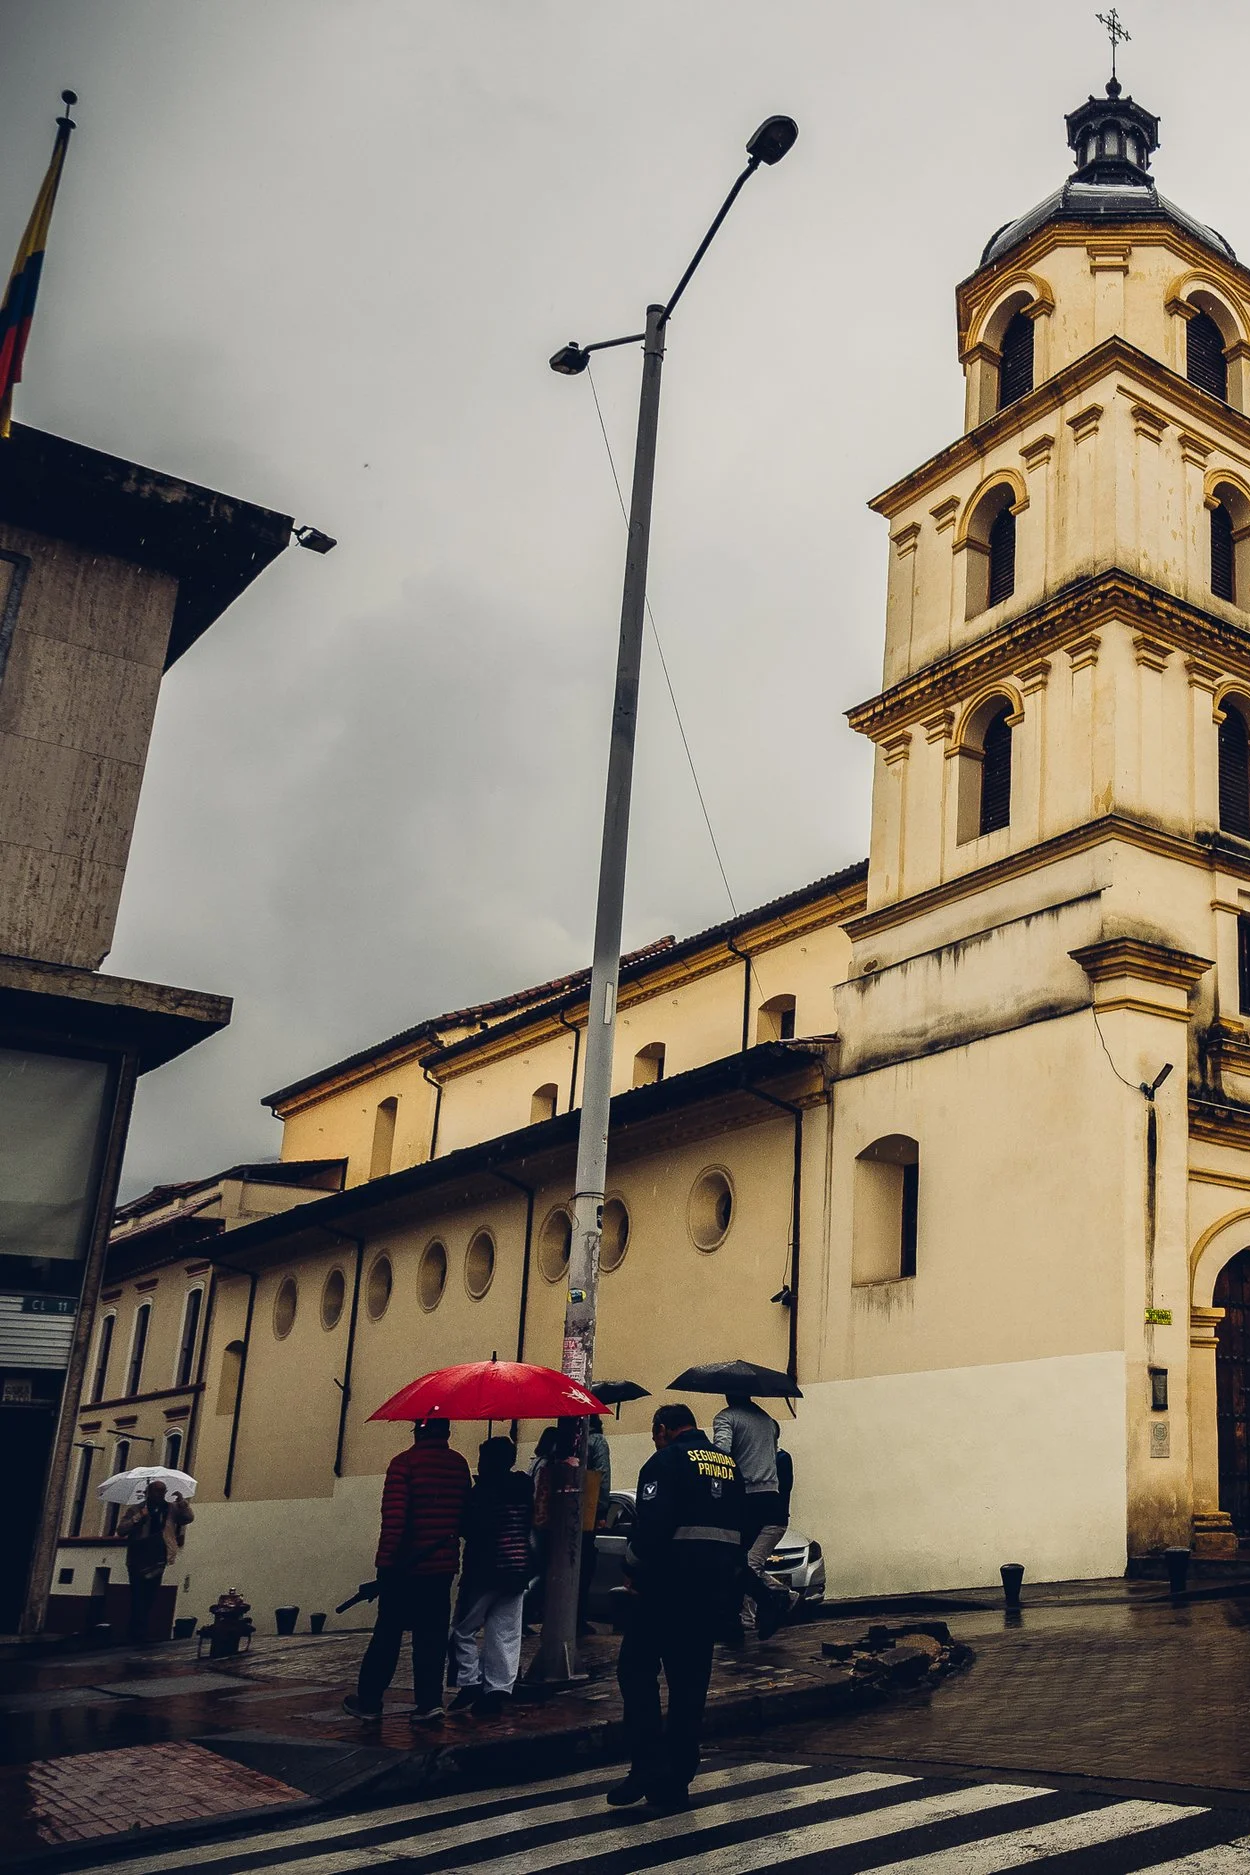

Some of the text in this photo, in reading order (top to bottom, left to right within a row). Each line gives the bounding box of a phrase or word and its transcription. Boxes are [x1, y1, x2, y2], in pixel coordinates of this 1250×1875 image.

[32, 1300, 68, 1312] CL 11
[687, 1449, 736, 1467] SEGURIDAD
[698, 1463, 734, 1480] PRIVADA
